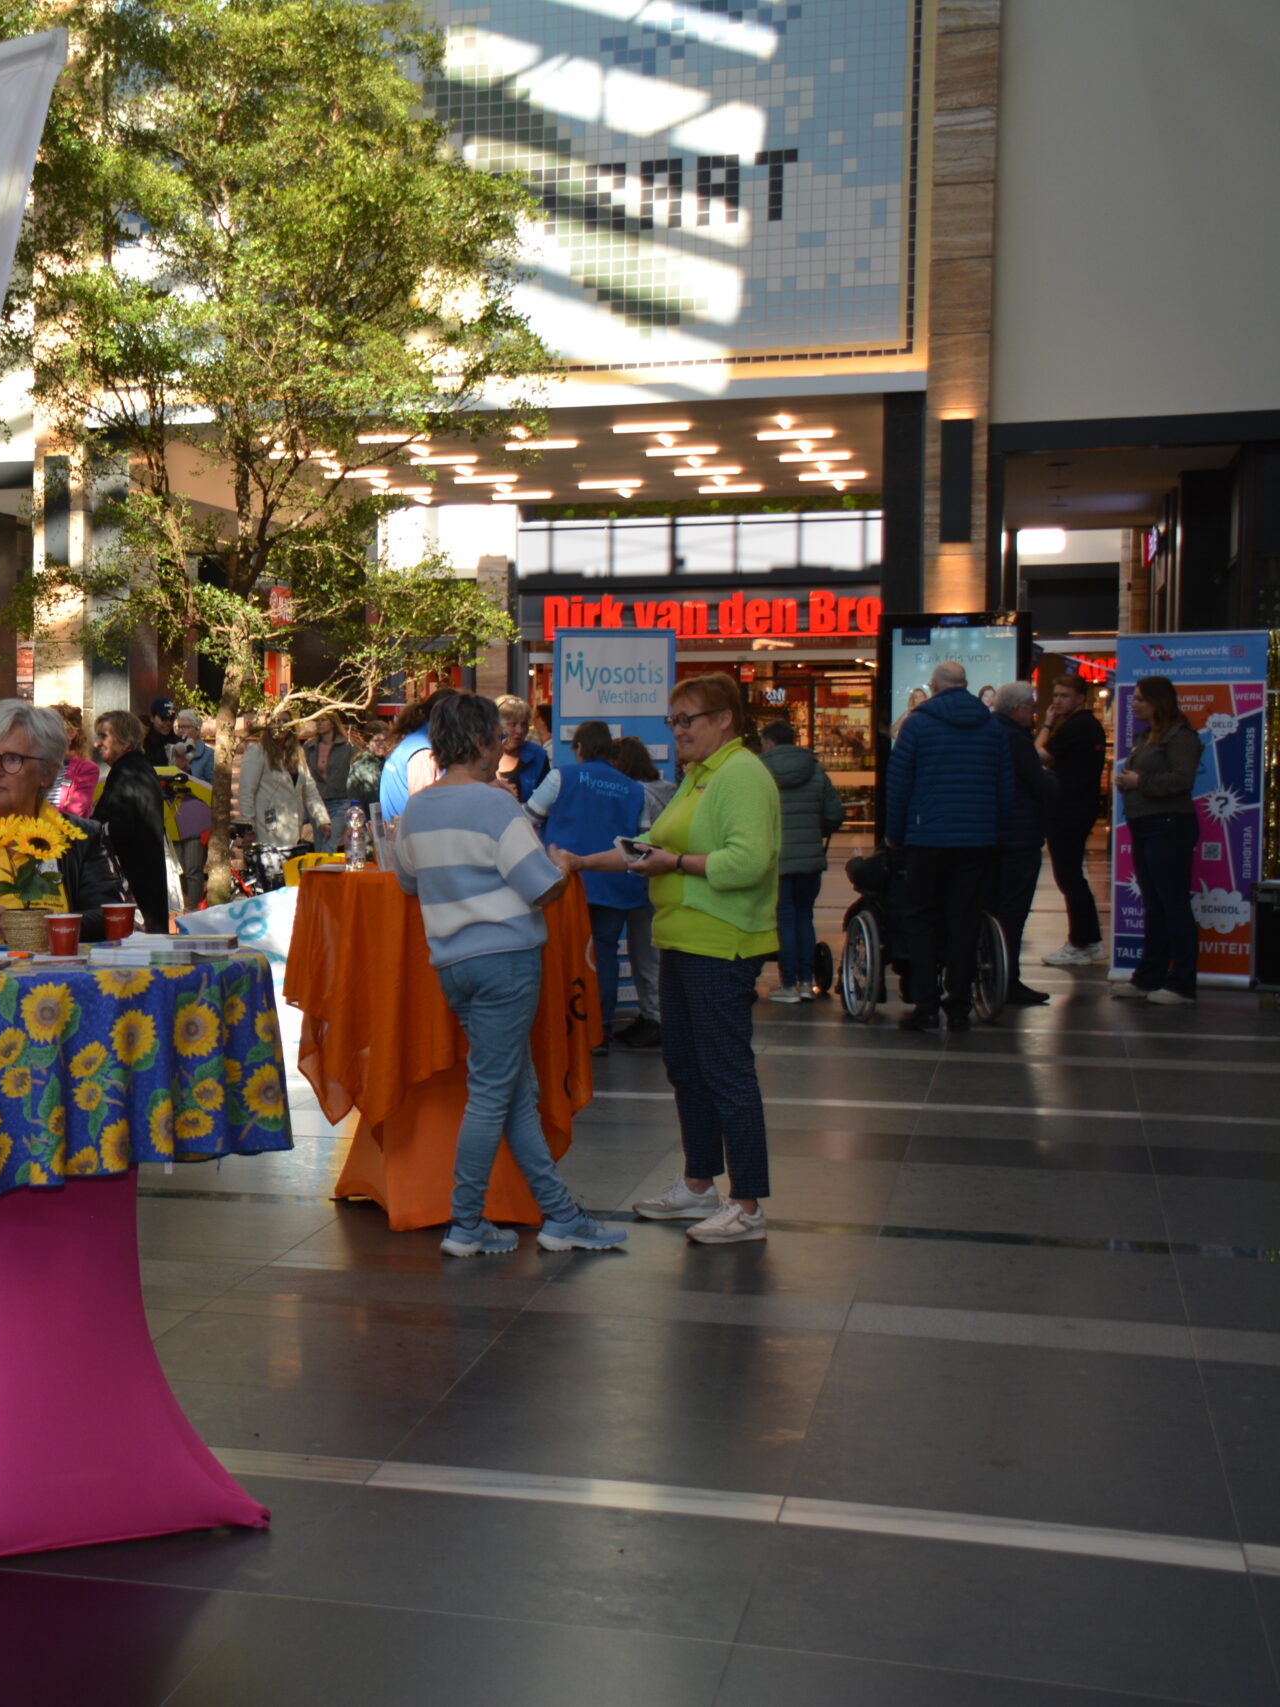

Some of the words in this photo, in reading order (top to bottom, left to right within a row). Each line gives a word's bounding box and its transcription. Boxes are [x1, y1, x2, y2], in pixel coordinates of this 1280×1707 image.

[543, 594, 624, 638] Dirk
[634, 598, 708, 635] van
[718, 592, 798, 634] den
[809, 590, 883, 633] Bro
[915, 652, 939, 663] Ruik
[968, 654, 992, 663] van
[564, 652, 664, 693] Myosotis
[1132, 668, 1148, 676] WIJ
[1150, 667, 1177, 676] STAAN
[1180, 667, 1202, 675] VOOR
[1204, 665, 1251, 675] JONGEREN
[597, 688, 657, 705] Westland
[1235, 692, 1262, 701] WERK
[1245, 727, 1255, 792] SEKSUALITEIT
[579, 771, 630, 795] Myosotis
[1215, 796, 1229, 814] ?
[1242, 826, 1252, 879] VEILIGHEID
[1201, 904, 1241, 915] SCHOOL
